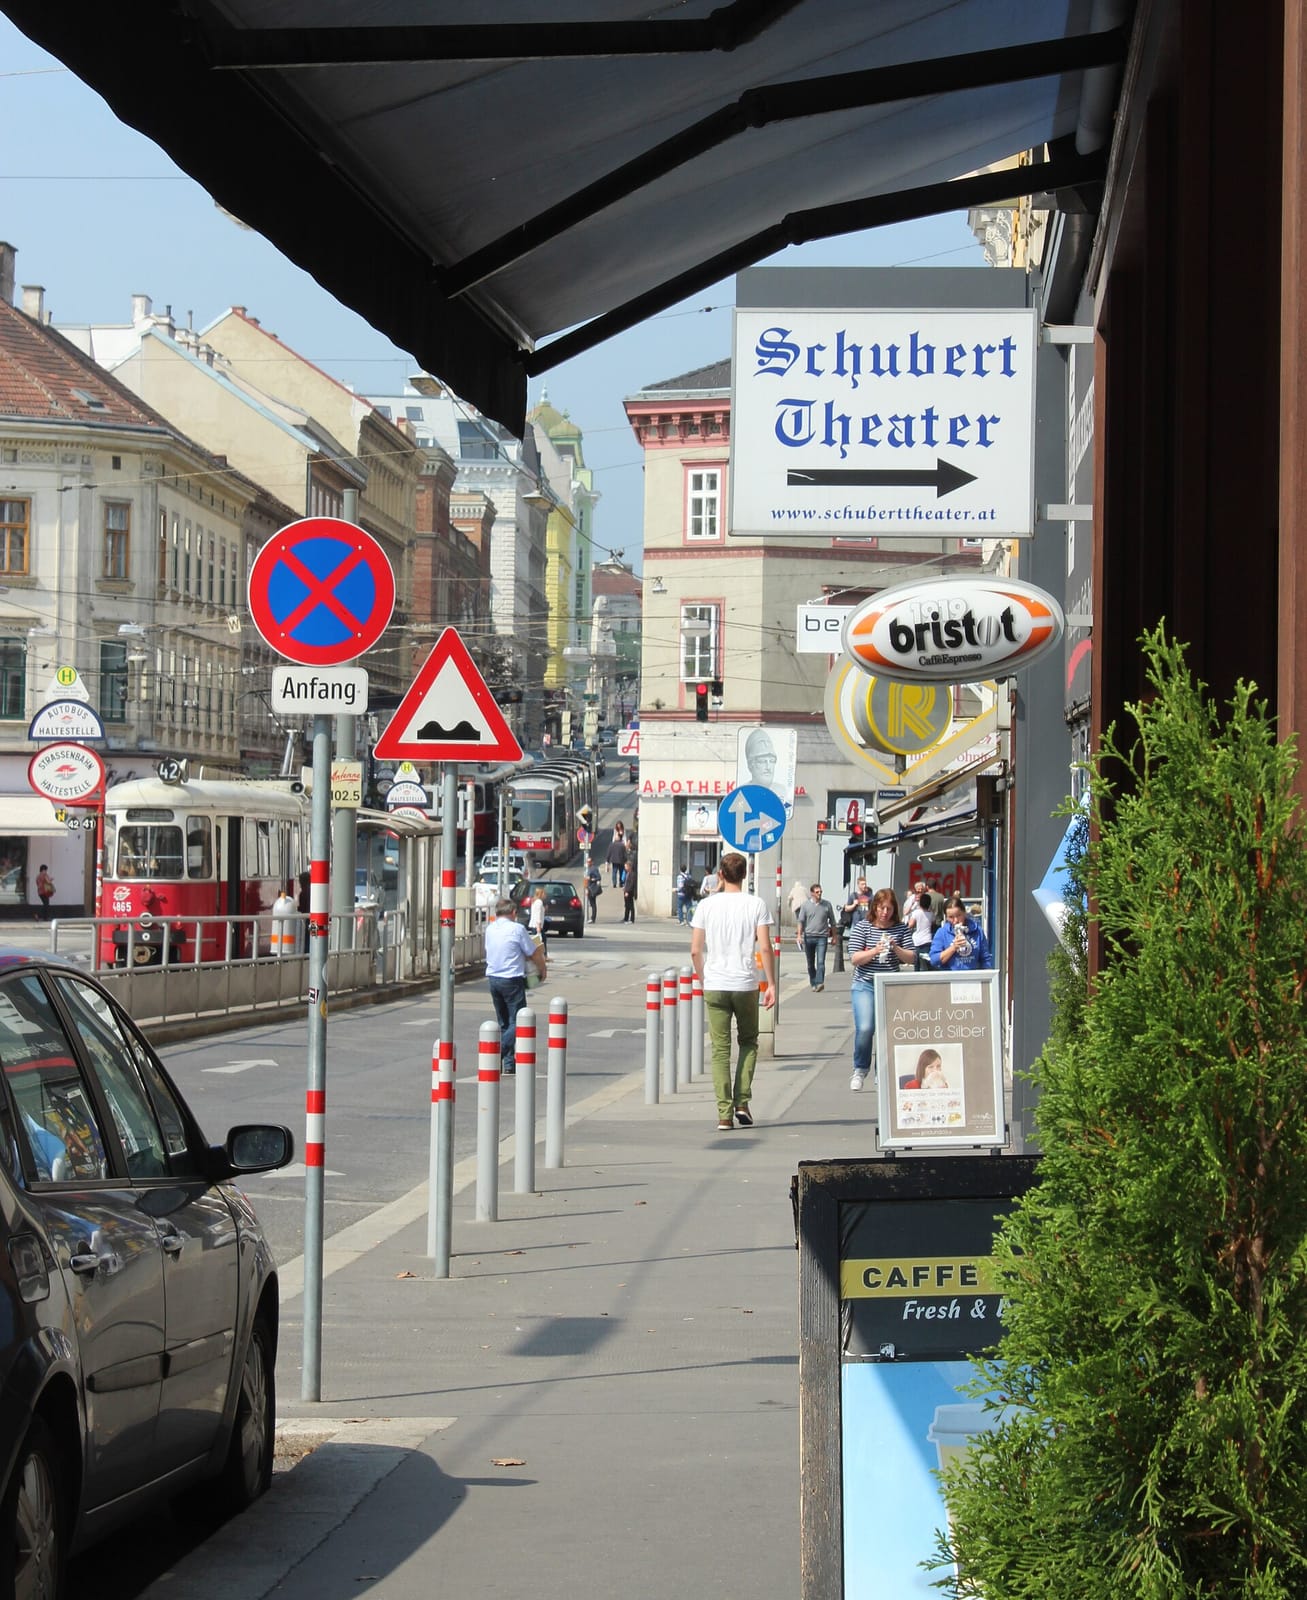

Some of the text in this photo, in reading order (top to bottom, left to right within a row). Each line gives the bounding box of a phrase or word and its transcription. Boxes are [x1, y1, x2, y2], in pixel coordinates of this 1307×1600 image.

[753, 327, 1017, 389] Schubert
[774, 398, 1001, 459] Theater
[771, 505, 997, 521] www.schuberttheater.at
[909, 599, 968, 623] 1919
[805, 614, 846, 632] be
[889, 606, 1018, 654] bristot
[62, 670, 72, 682] H
[282, 677, 356, 706] Anfang
[47, 705, 88, 720] AUTOBUS
[39, 726, 95, 735] HALTESTELLE
[38, 750, 94, 770] STRASSENBAHN
[159, 763, 178, 780] 42
[40, 779, 92, 797] HALTESTELLE
[643, 780, 736, 793] APOTHEK
[68, 820, 79, 829] 42
[83, 819, 94, 828] 41
[893, 1008, 974, 1022] Ankauf von
[893, 1025, 986, 1040] Gold & Silber
[902, 1299, 960, 1320] Fresh
[970, 1298, 986, 1319] &
